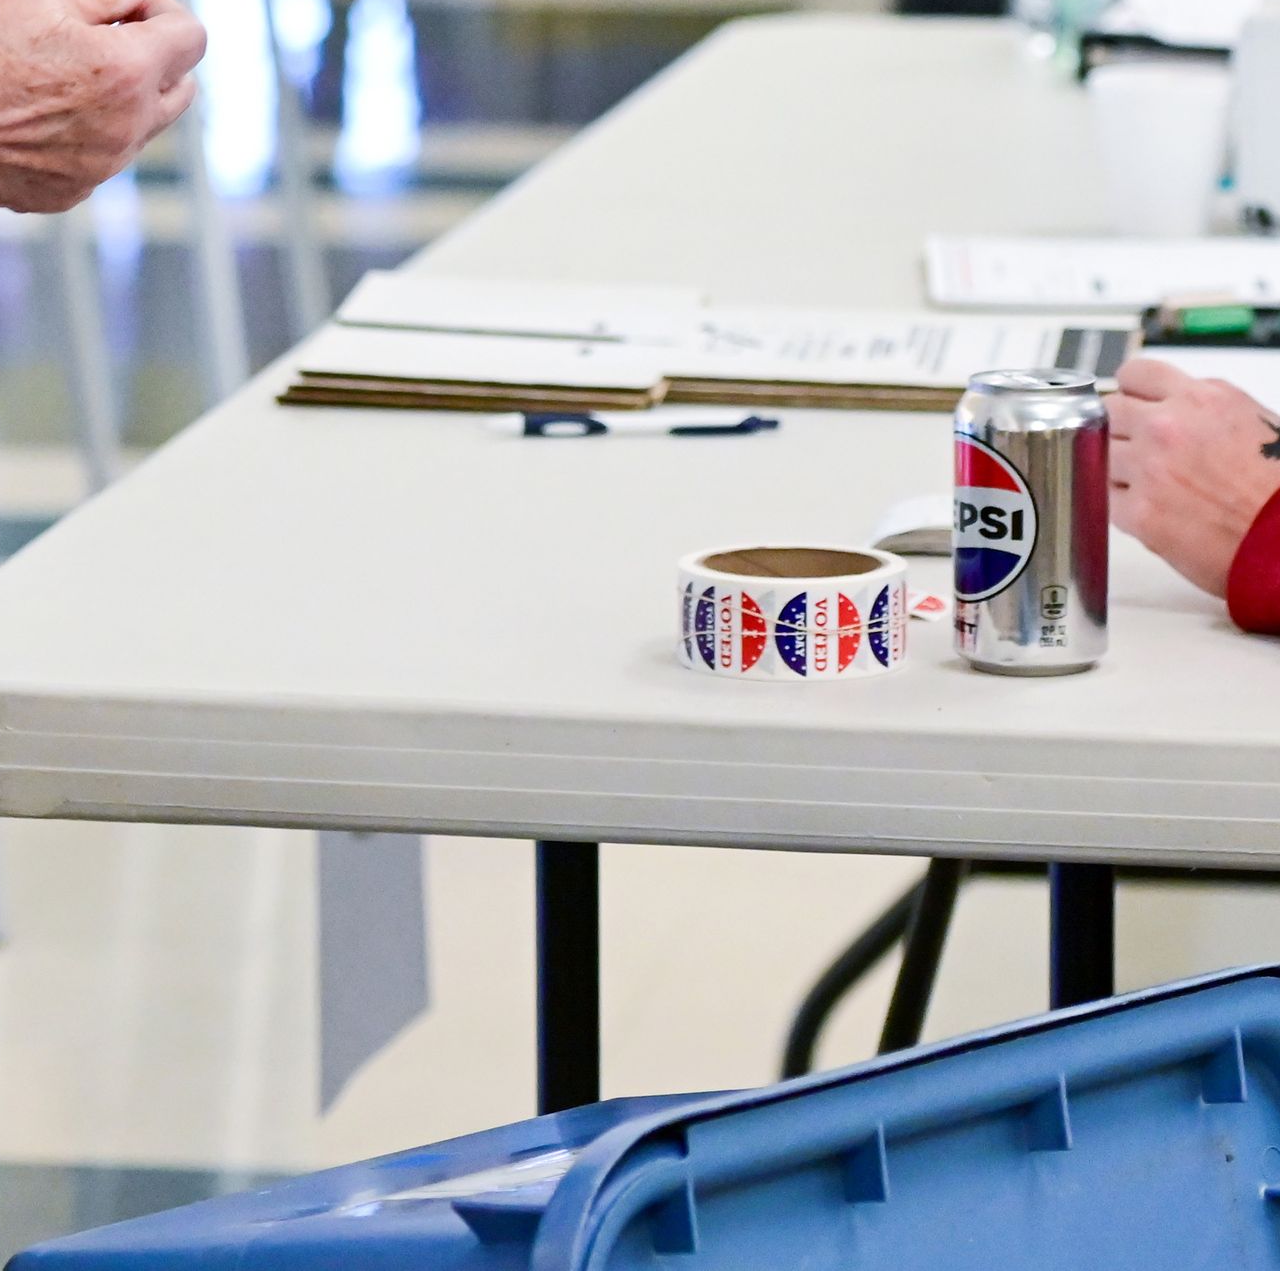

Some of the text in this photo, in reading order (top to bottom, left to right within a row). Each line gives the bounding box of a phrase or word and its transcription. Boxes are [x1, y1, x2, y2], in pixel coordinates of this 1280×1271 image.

[954, 499, 1024, 541] PSI
[720, 594, 732, 668] VOTED
[814, 597, 827, 672] VOTED
